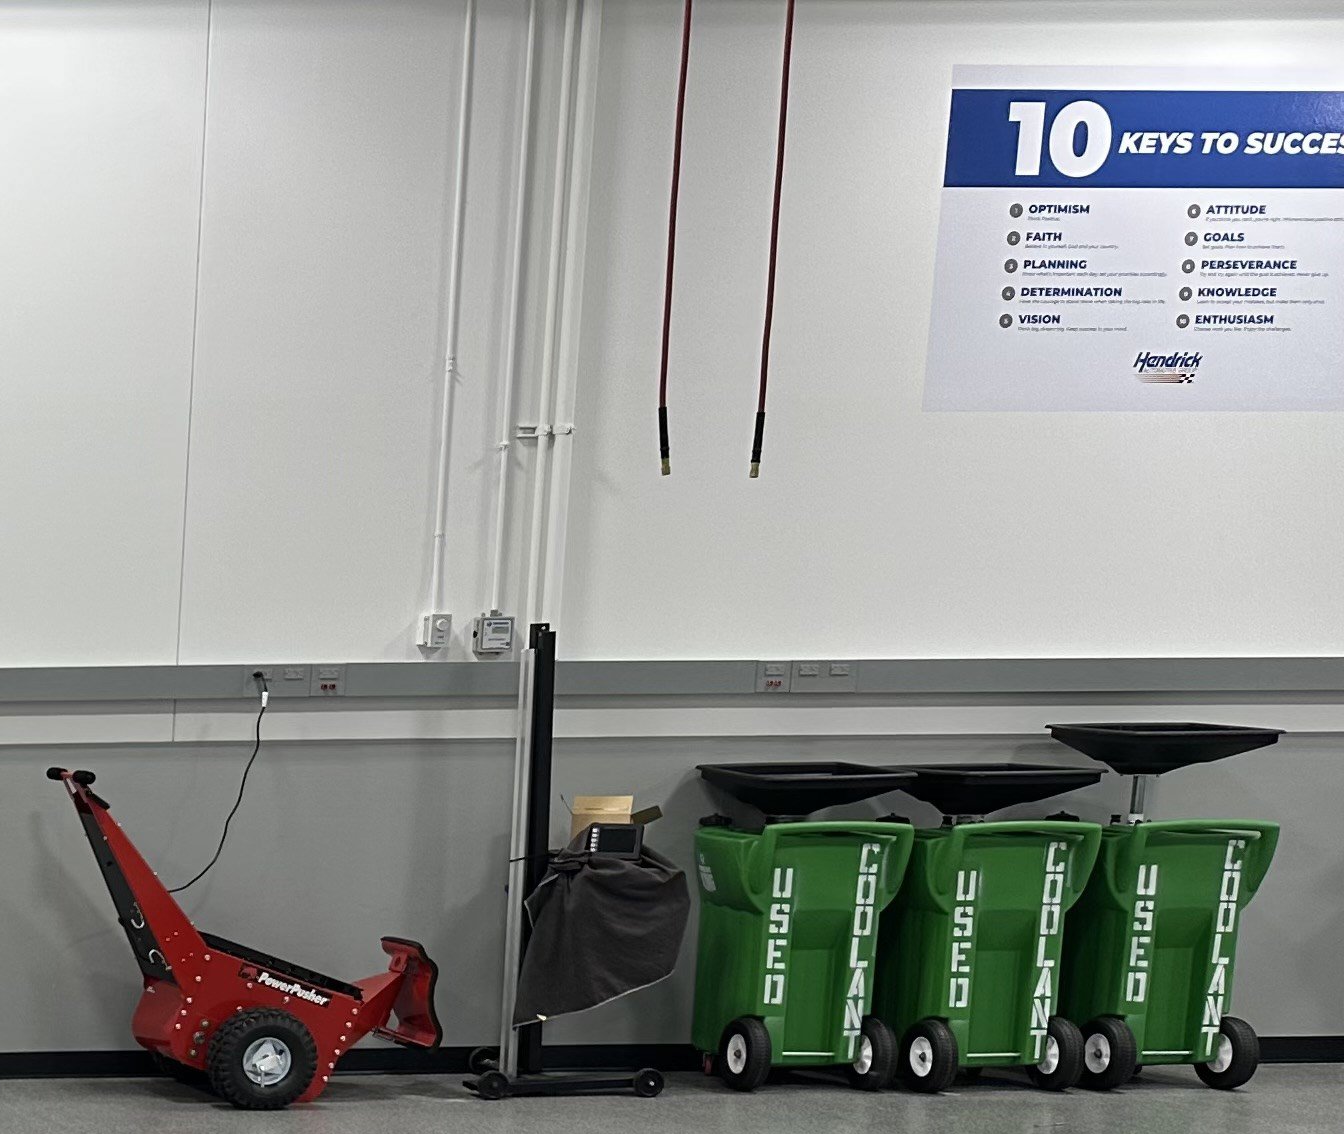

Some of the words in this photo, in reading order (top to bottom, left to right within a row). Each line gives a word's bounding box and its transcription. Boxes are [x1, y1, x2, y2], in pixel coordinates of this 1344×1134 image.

[1008, 100, 1112, 178] 10
[1118, 132, 1194, 154] KEYS
[1201, 132, 1239, 154] TO
[1028, 204, 1090, 214] OPTIMISM
[1206, 205, 1267, 215] ATTITUDE
[1025, 232, 1062, 241] FAITH
[1203, 232, 1245, 242] GOALS
[1023, 260, 1088, 269] PLANNING
[1201, 260, 1297, 270] PERSEVERANCE
[1020, 287, 1122, 297] DETERMINATION
[1197, 288, 1277, 297] KNOWLEDGE
[1018, 314, 1061, 324] VISION
[1194, 315, 1274, 324] ENTHUSIASM
[1132, 352, 1203, 373] Hendrick
[764, 868, 794, 1005] USED
[1126, 864, 1158, 1003] USED
[949, 870, 977, 1008] USED
[843, 843, 881, 1059] COOLANT
[1030, 842, 1067, 1059] COOLANT
[1201, 839, 1245, 1056] COOLANT
[257, 972, 330, 1006] PowerPusher
